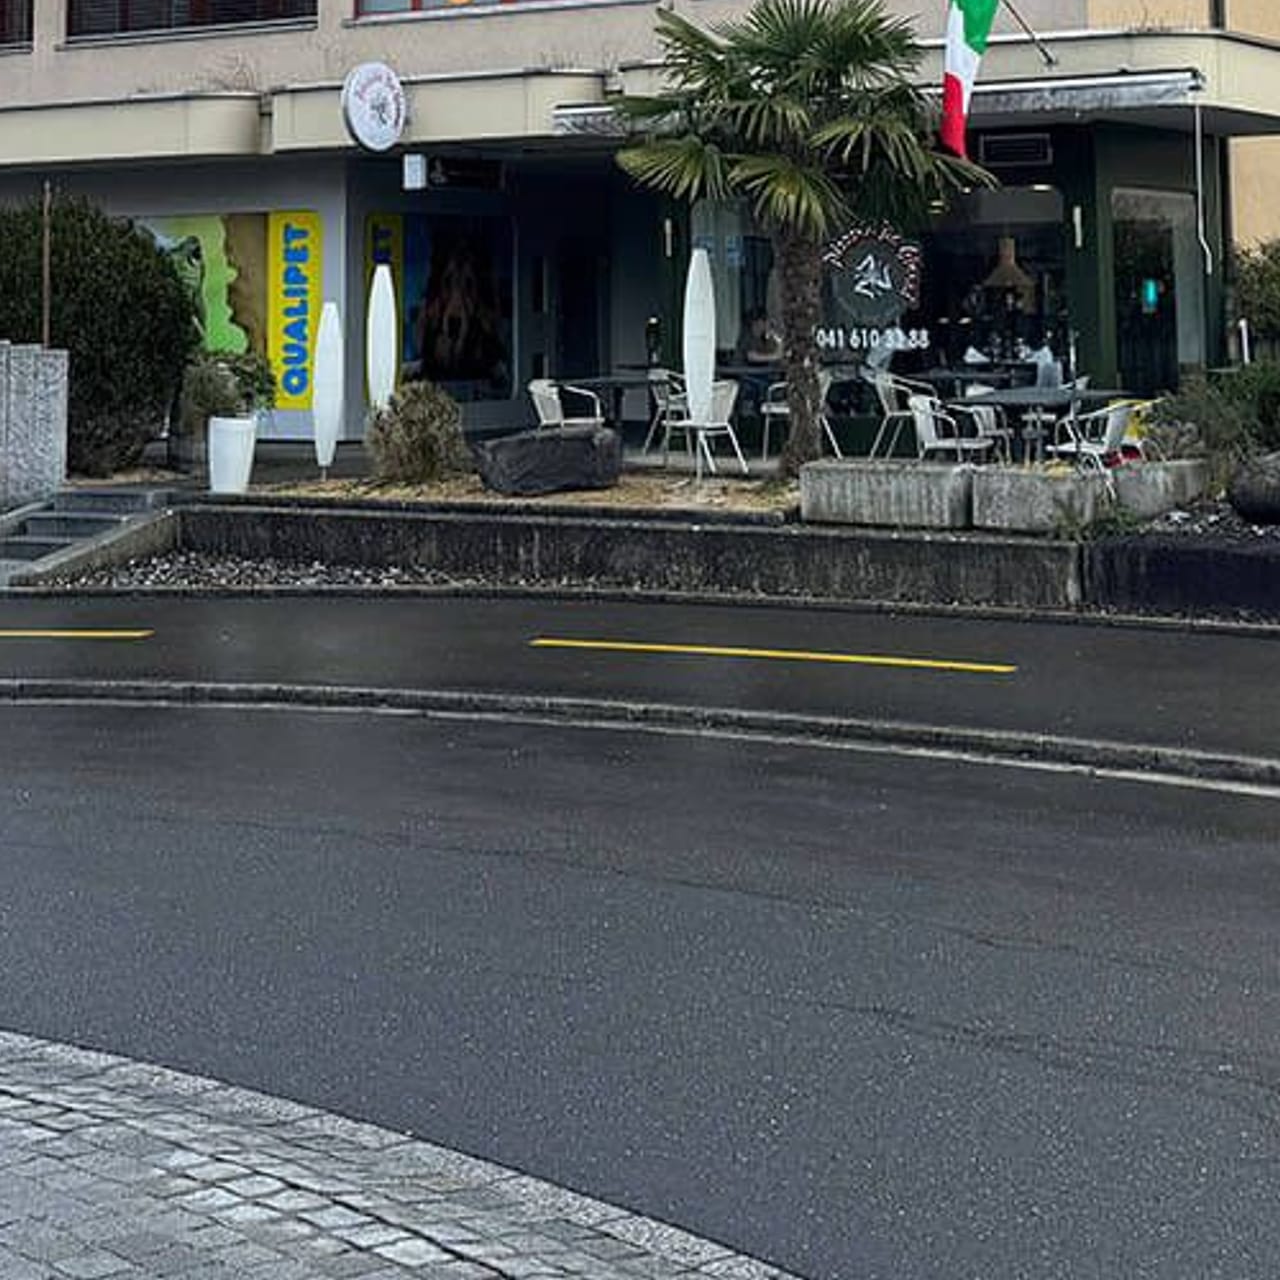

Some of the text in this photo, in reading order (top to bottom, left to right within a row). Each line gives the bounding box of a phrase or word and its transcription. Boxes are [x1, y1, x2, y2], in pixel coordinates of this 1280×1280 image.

[282, 223, 309, 396] QUALIPET
[816, 327, 844, 349] 041
[849, 327, 880, 349] 610
